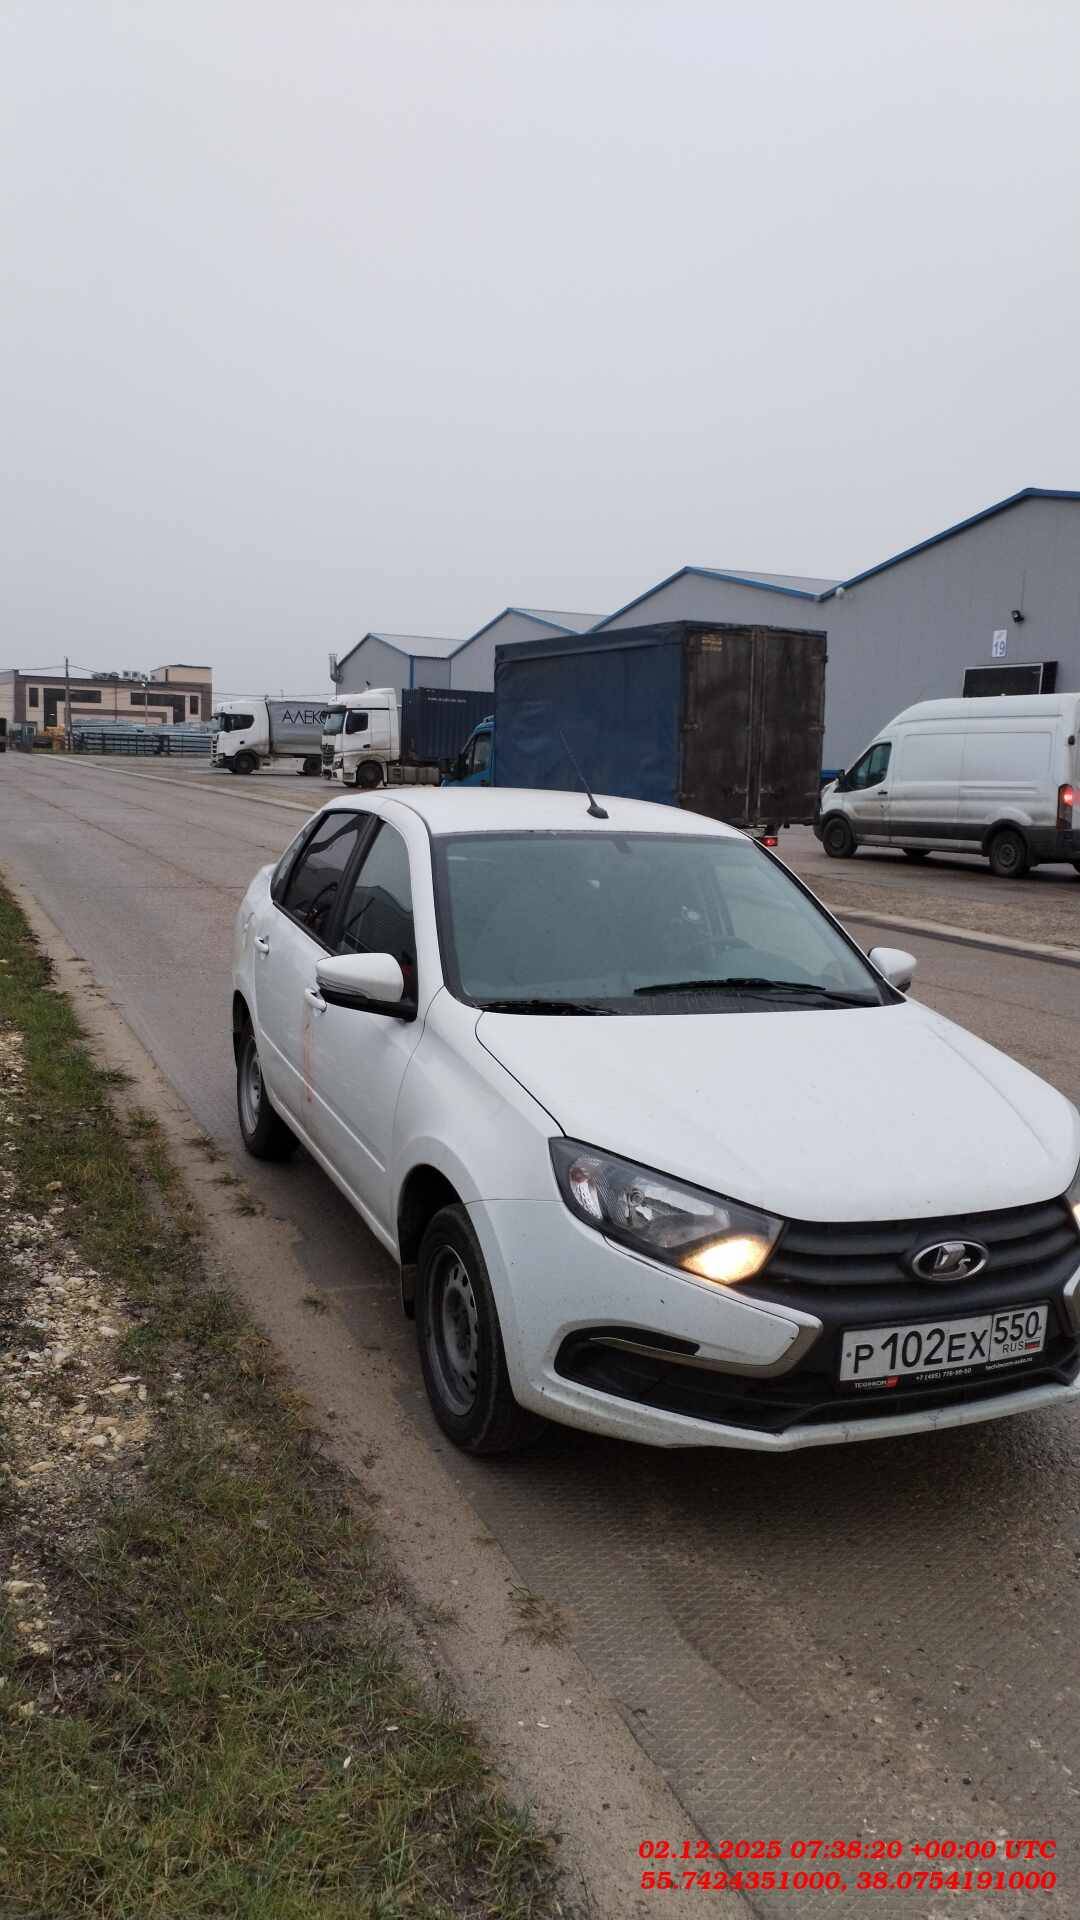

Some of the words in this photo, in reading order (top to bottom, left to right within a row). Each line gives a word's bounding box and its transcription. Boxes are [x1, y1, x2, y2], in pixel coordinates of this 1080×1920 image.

[994, 640, 1006, 656] 19
[993, 1311, 1040, 1344] 550
[1002, 1340, 1026, 1354] RUS
